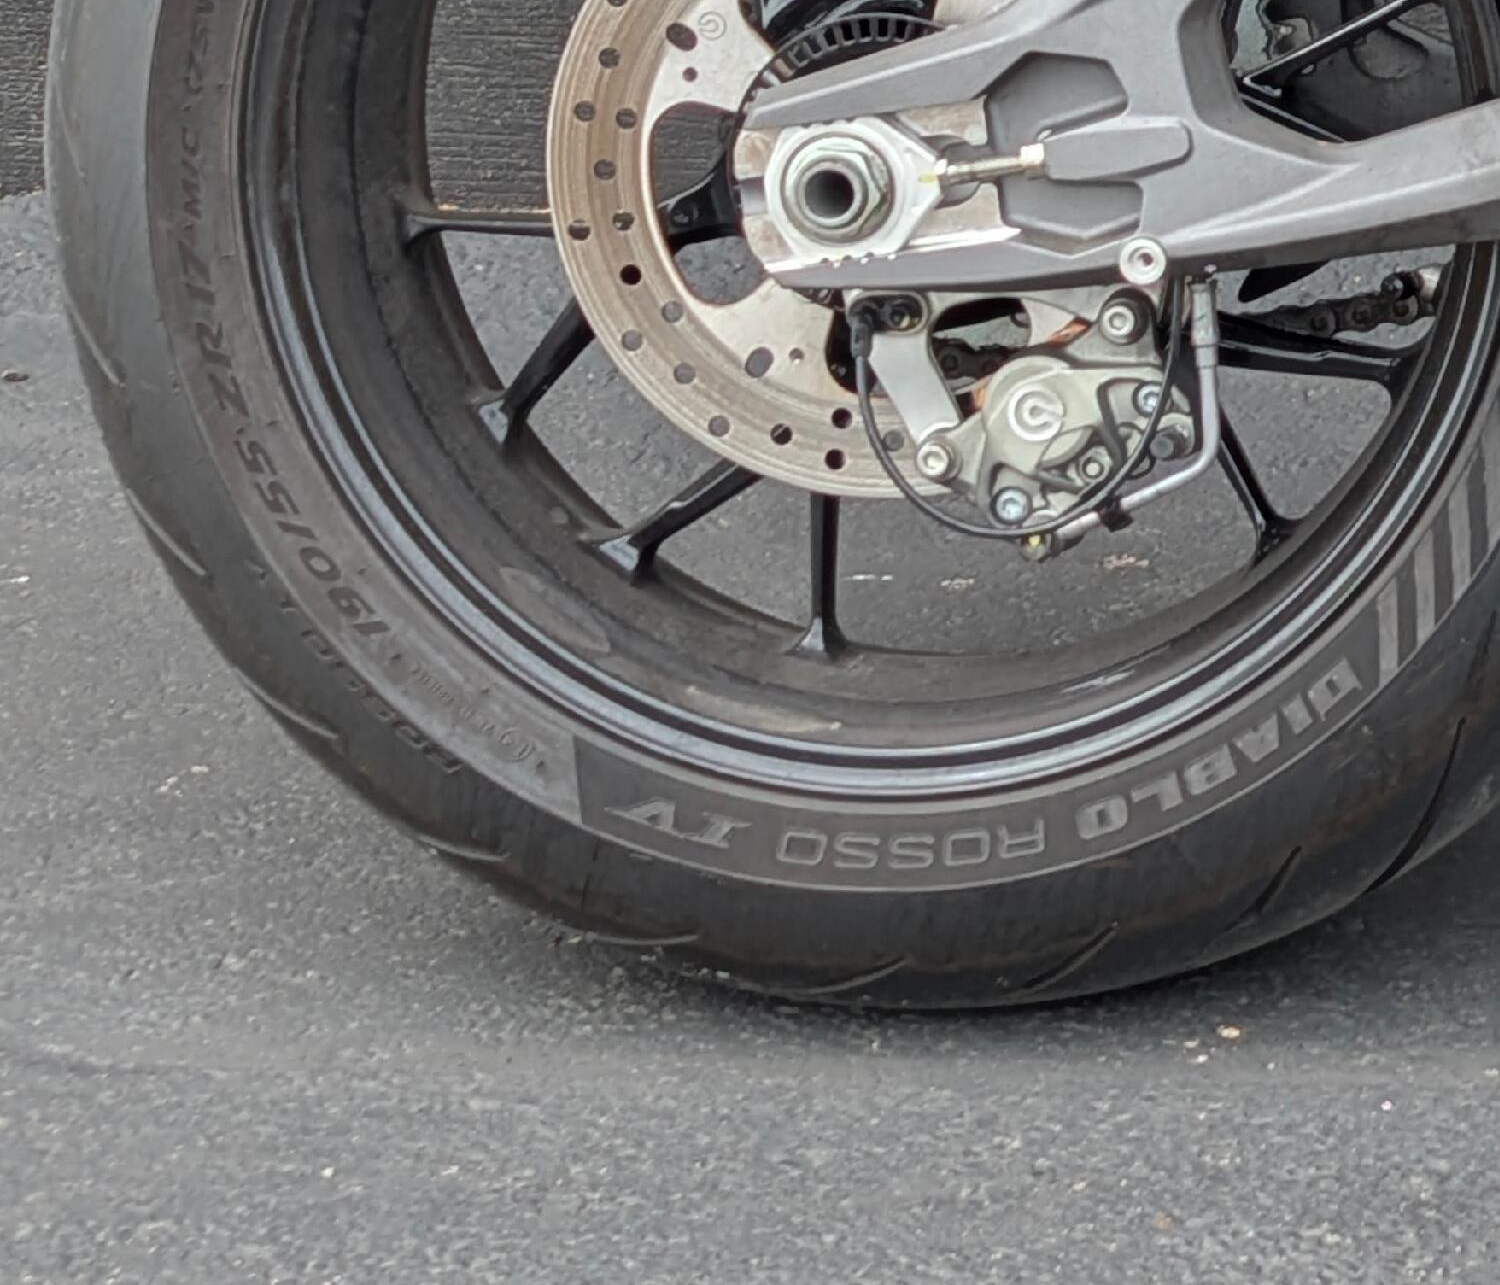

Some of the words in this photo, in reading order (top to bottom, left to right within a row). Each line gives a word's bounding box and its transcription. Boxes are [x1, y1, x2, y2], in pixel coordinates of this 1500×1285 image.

[234, 439, 391, 637] 190/55
[1075, 655, 1368, 841] DIABLO
[605, 796, 756, 849] IV
[774, 816, 1048, 872] ROSSO
